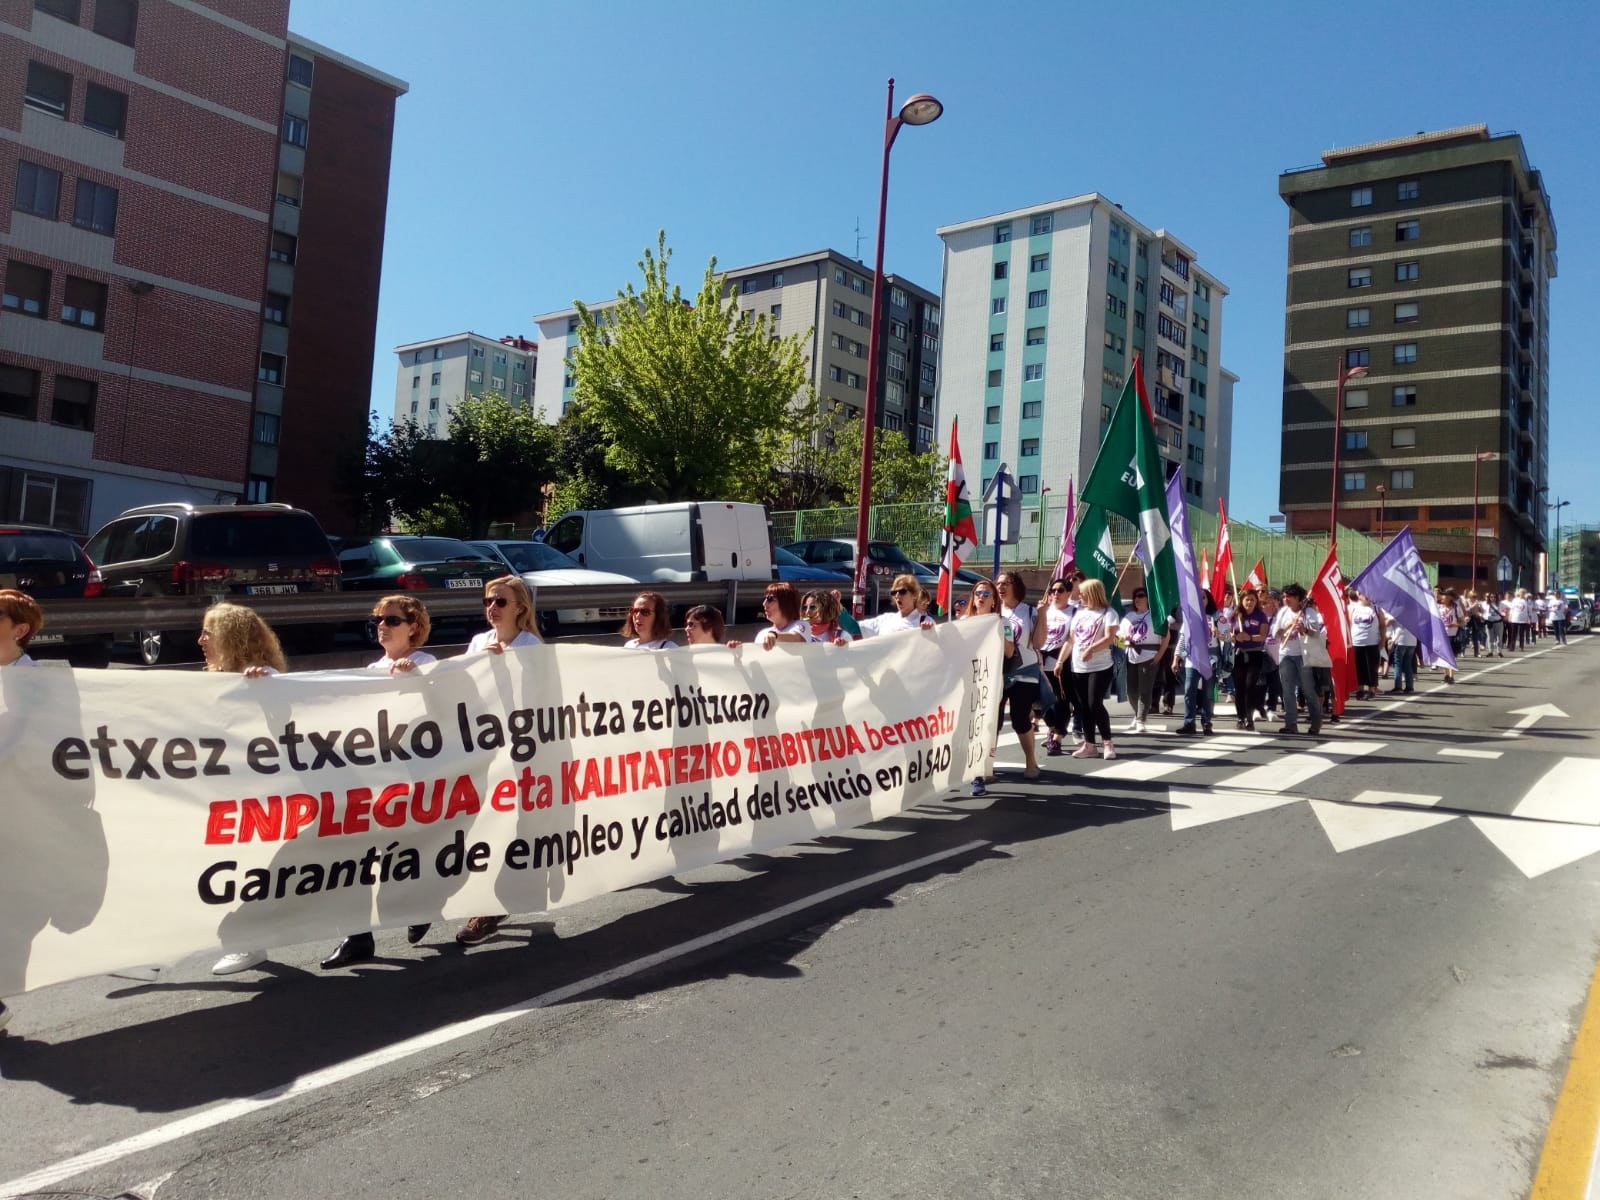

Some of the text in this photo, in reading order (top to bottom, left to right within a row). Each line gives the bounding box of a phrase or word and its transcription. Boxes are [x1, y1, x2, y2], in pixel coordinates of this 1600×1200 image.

[971, 655, 989, 683] ELA
[51, 683, 771, 781] etxez etxeko laguntza zerbitzuan
[204, 705, 956, 846] ENPLEGUA eta KALITATEZKO ZERBITZUA bermatu
[197, 839, 421, 906] Garantía
[434, 829, 491, 879] de
[504, 813, 625, 877] empleo
[629, 815, 650, 862] y
[655, 785, 742, 843] calidad
[746, 780, 782, 822] del
[784, 773, 873, 815] servicio
[875, 763, 904, 793] en
[907, 749, 923, 785] el
[924, 743, 952, 781] SAD
